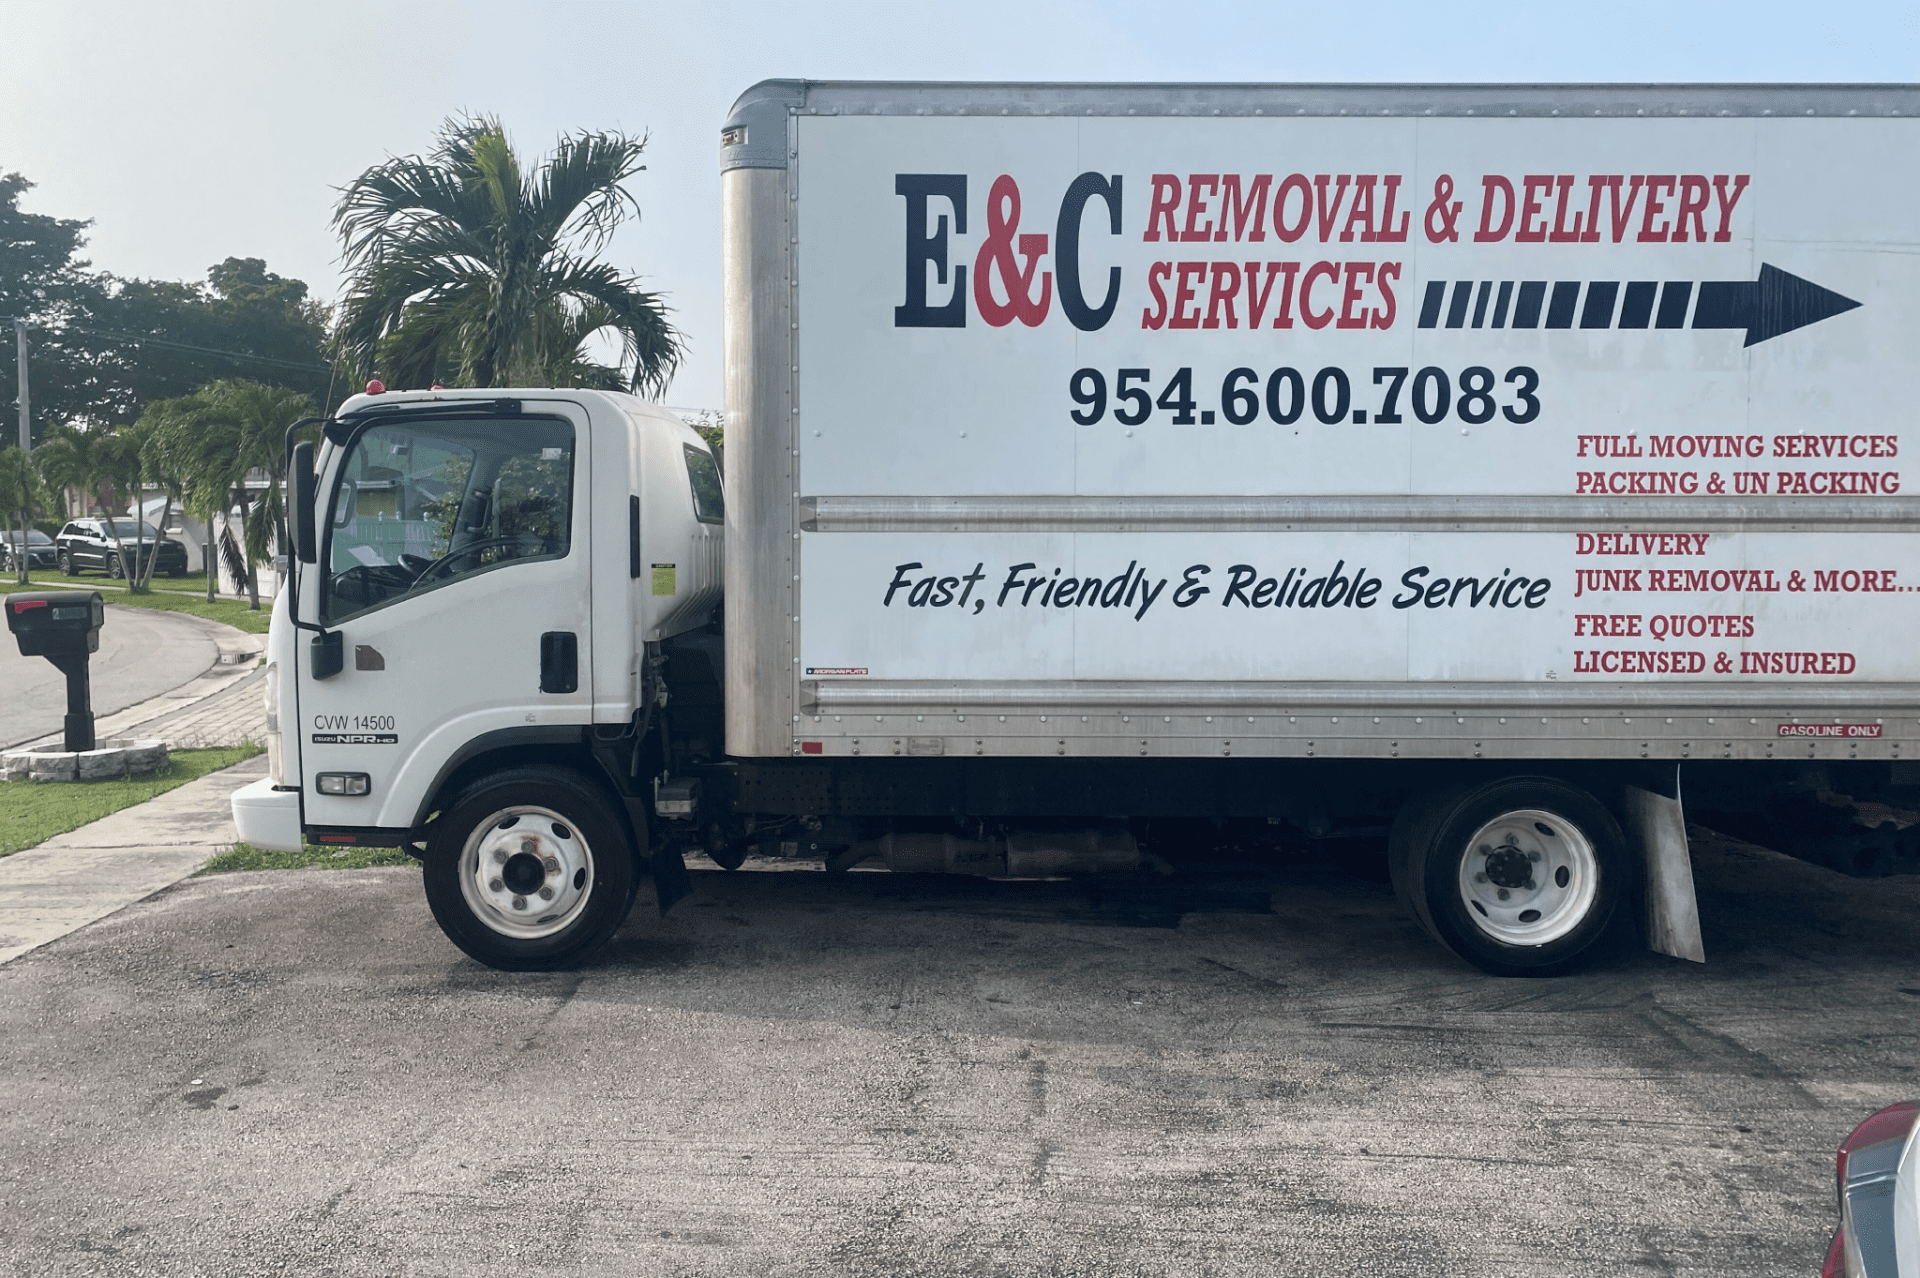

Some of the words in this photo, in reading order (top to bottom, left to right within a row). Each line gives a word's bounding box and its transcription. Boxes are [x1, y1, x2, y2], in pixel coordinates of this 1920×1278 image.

[1143, 173, 1411, 243] REMOVAL
[1424, 173, 1464, 243] &
[1473, 174, 1751, 243] DELIVERY
[894, 172, 1123, 331] E&C
[1141, 260, 1402, 331] SERVICES
[1069, 365, 1541, 427] 954.600.7083
[1576, 434, 1643, 458] FULL
[1648, 435, 1765, 458] MOVING
[1772, 434, 1899, 458] SERVICES
[1575, 471, 1699, 495] PACKING
[1706, 471, 1726, 495] &
[1733, 471, 1770, 494] UN
[1776, 471, 1901, 495] PACKING
[1575, 532, 1710, 556] DELIVERY
[883, 562, 986, 616] Fast,
[996, 560, 1167, 622] Friendly
[1172, 564, 1211, 609] &
[1221, 559, 1383, 609] Reliable
[1391, 565, 1552, 610] Service
[1574, 569, 1643, 598] JUNK
[1648, 569, 1781, 592] REMOVAL
[1786, 569, 1806, 593] &
[1574, 614, 1642, 637] FREE
[1649, 614, 1755, 642] QUOTES
[1573, 650, 1706, 674] LICENSED
[1713, 651, 1734, 674] &
[1739, 652, 1856, 675] INSURED
[353, 715, 395, 731] 14500
[1779, 726, 1844, 737] GASOLINE
[1848, 726, 1881, 737] ONLY
[337, 735, 376, 743] NPR
